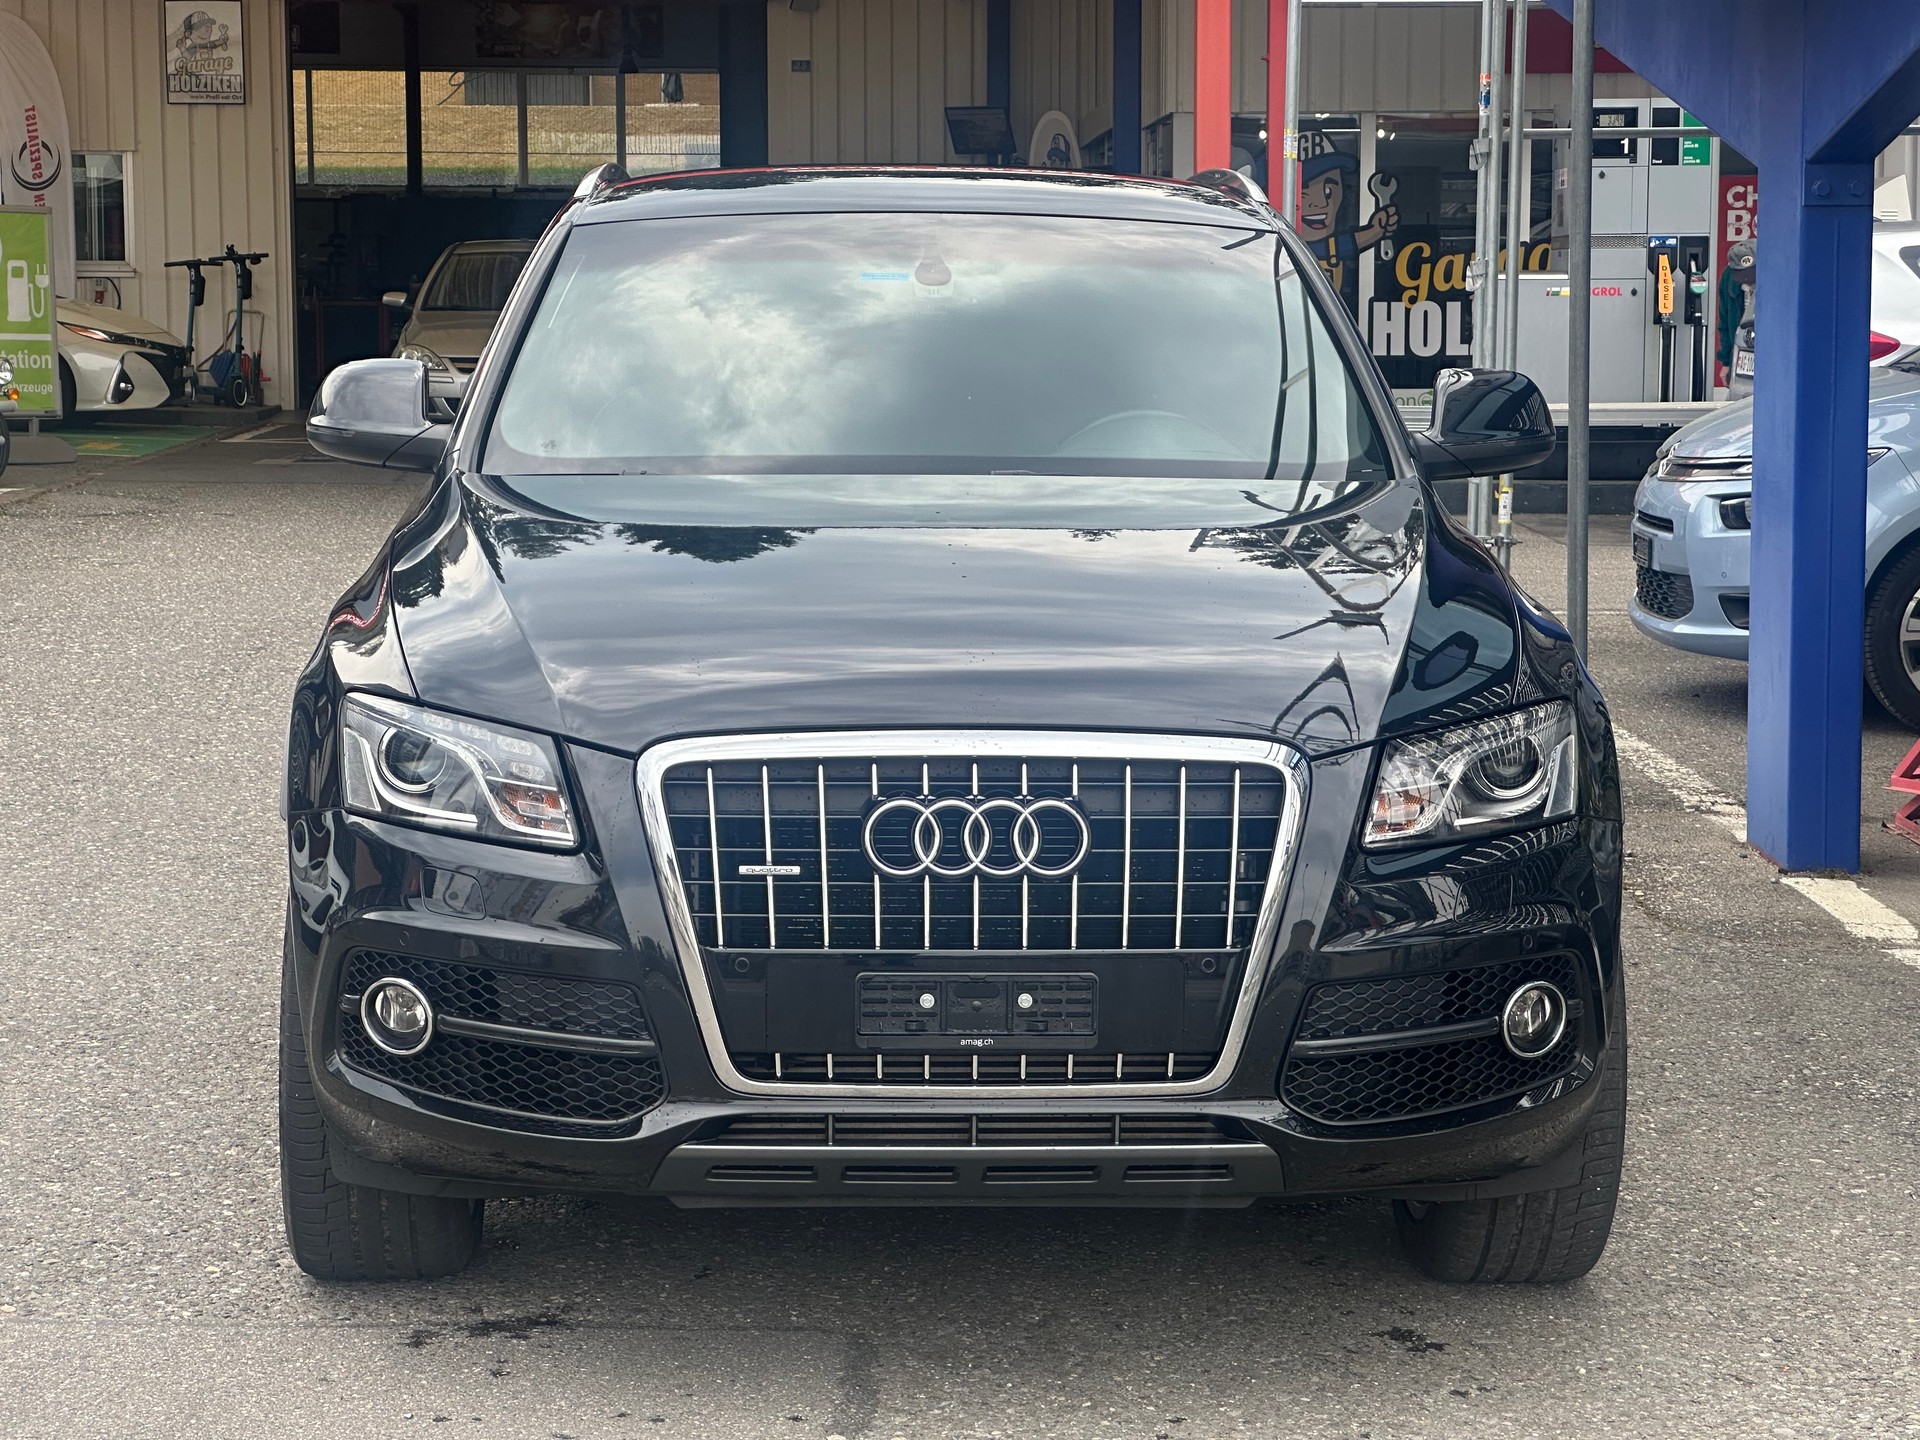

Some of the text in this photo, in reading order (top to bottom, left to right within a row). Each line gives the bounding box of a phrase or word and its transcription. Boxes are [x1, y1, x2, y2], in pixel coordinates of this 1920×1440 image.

[175, 57, 233, 76] Garage
[169, 75, 242, 93] HOLZIKEN
[1298, 133, 1324, 161] GB
[1620, 138, 1629, 154] 1
[1726, 210, 1757, 241] B
[1592, 286, 1623, 297] GROL
[1661, 265, 1669, 309] DIESEL
[1372, 301, 1473, 357] HOL
[960, 1038, 994, 1047] amag.ch
